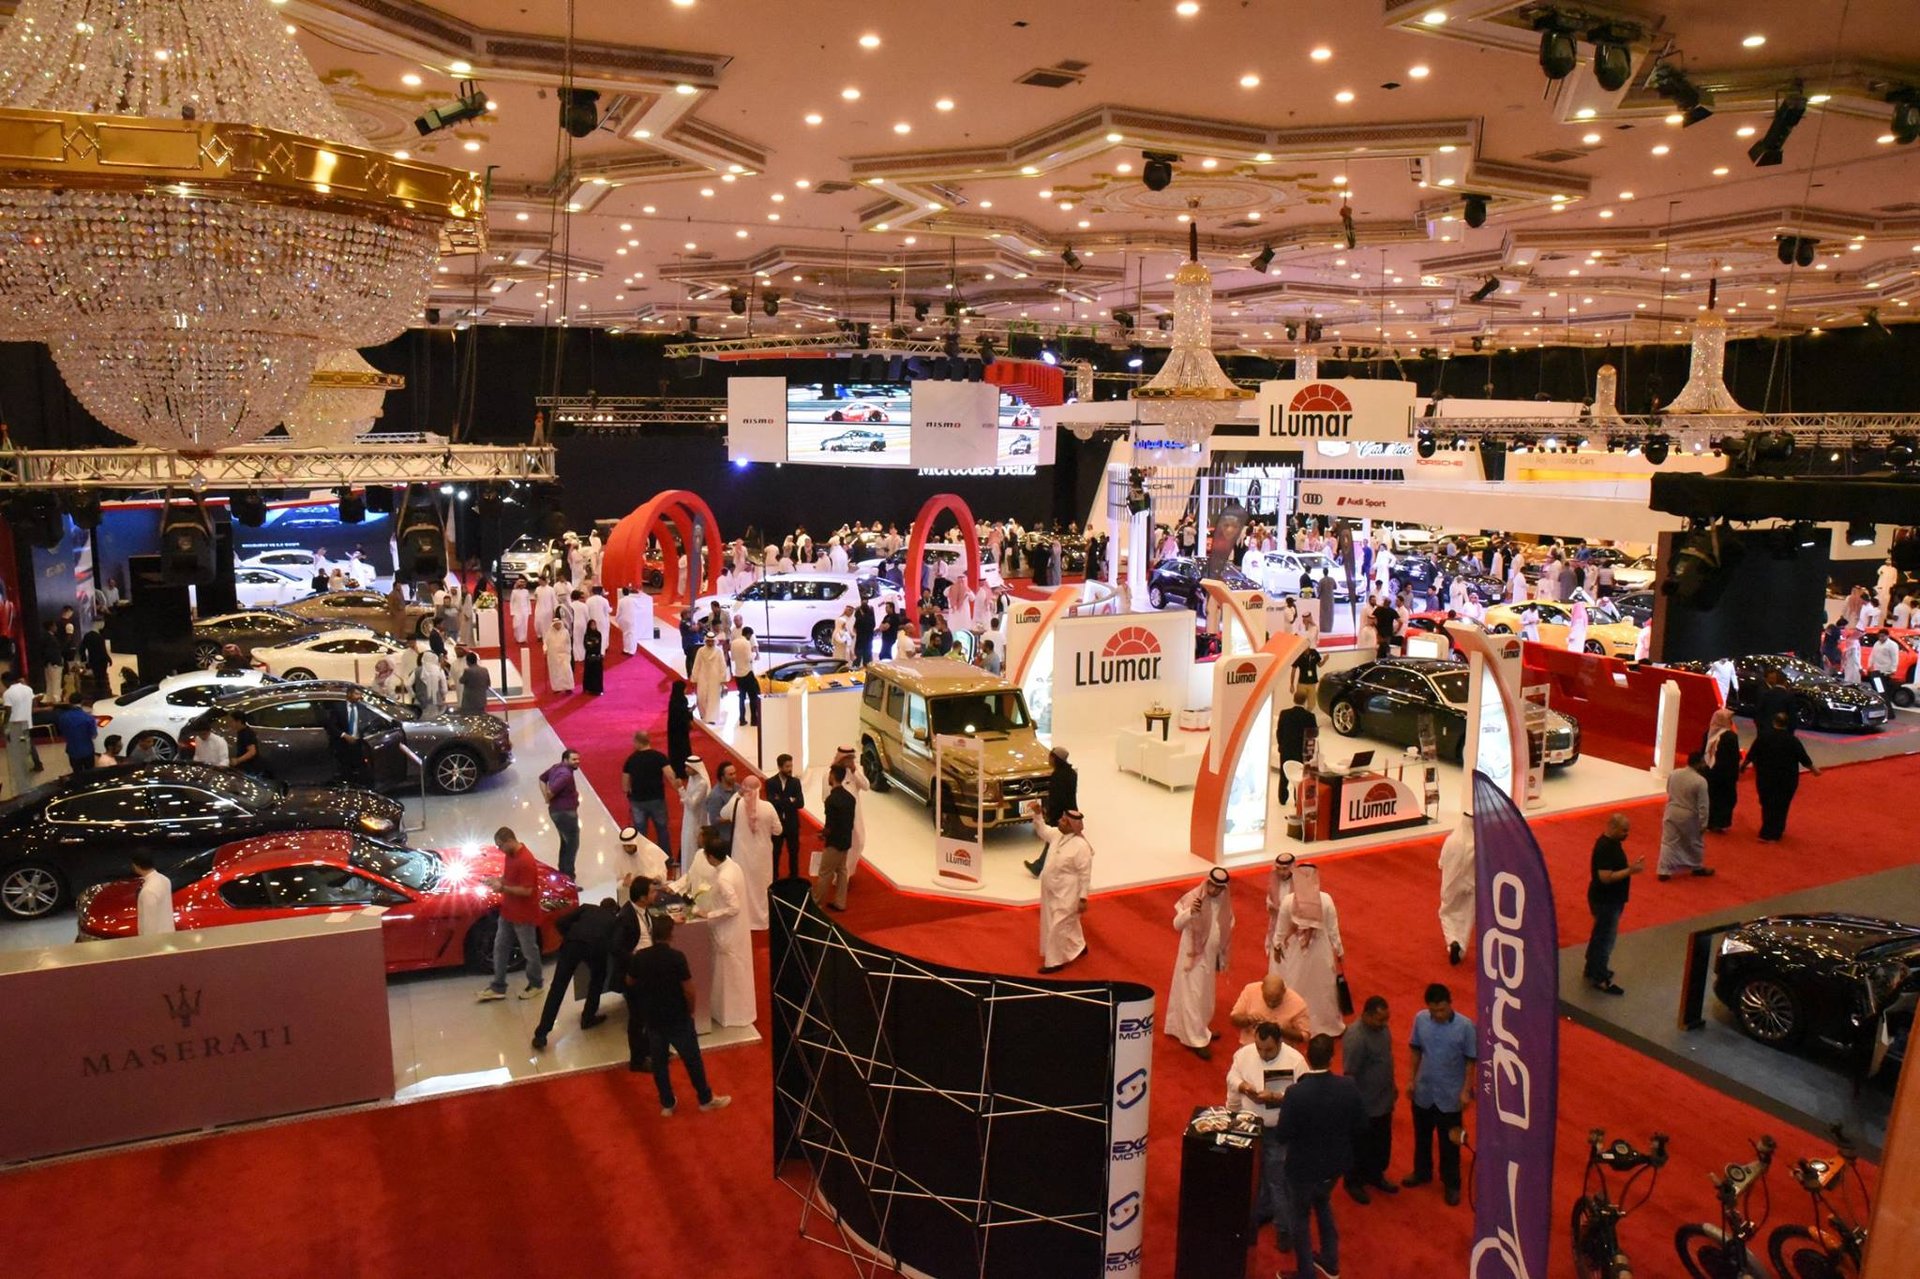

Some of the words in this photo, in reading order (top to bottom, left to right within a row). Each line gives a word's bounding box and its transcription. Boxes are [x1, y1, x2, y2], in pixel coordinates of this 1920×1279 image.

[1269, 404, 1353, 438] LLumar
[1347, 497, 1364, 505] Audi
[1365, 499, 1386, 507] Sport
[1015, 613, 1041, 624] LLumar
[1075, 651, 1161, 687] LLumar
[1226, 671, 1257, 685] LLumar
[1349, 799, 1397, 822] LLumar
[82, 1025, 294, 1079] MASERATI
